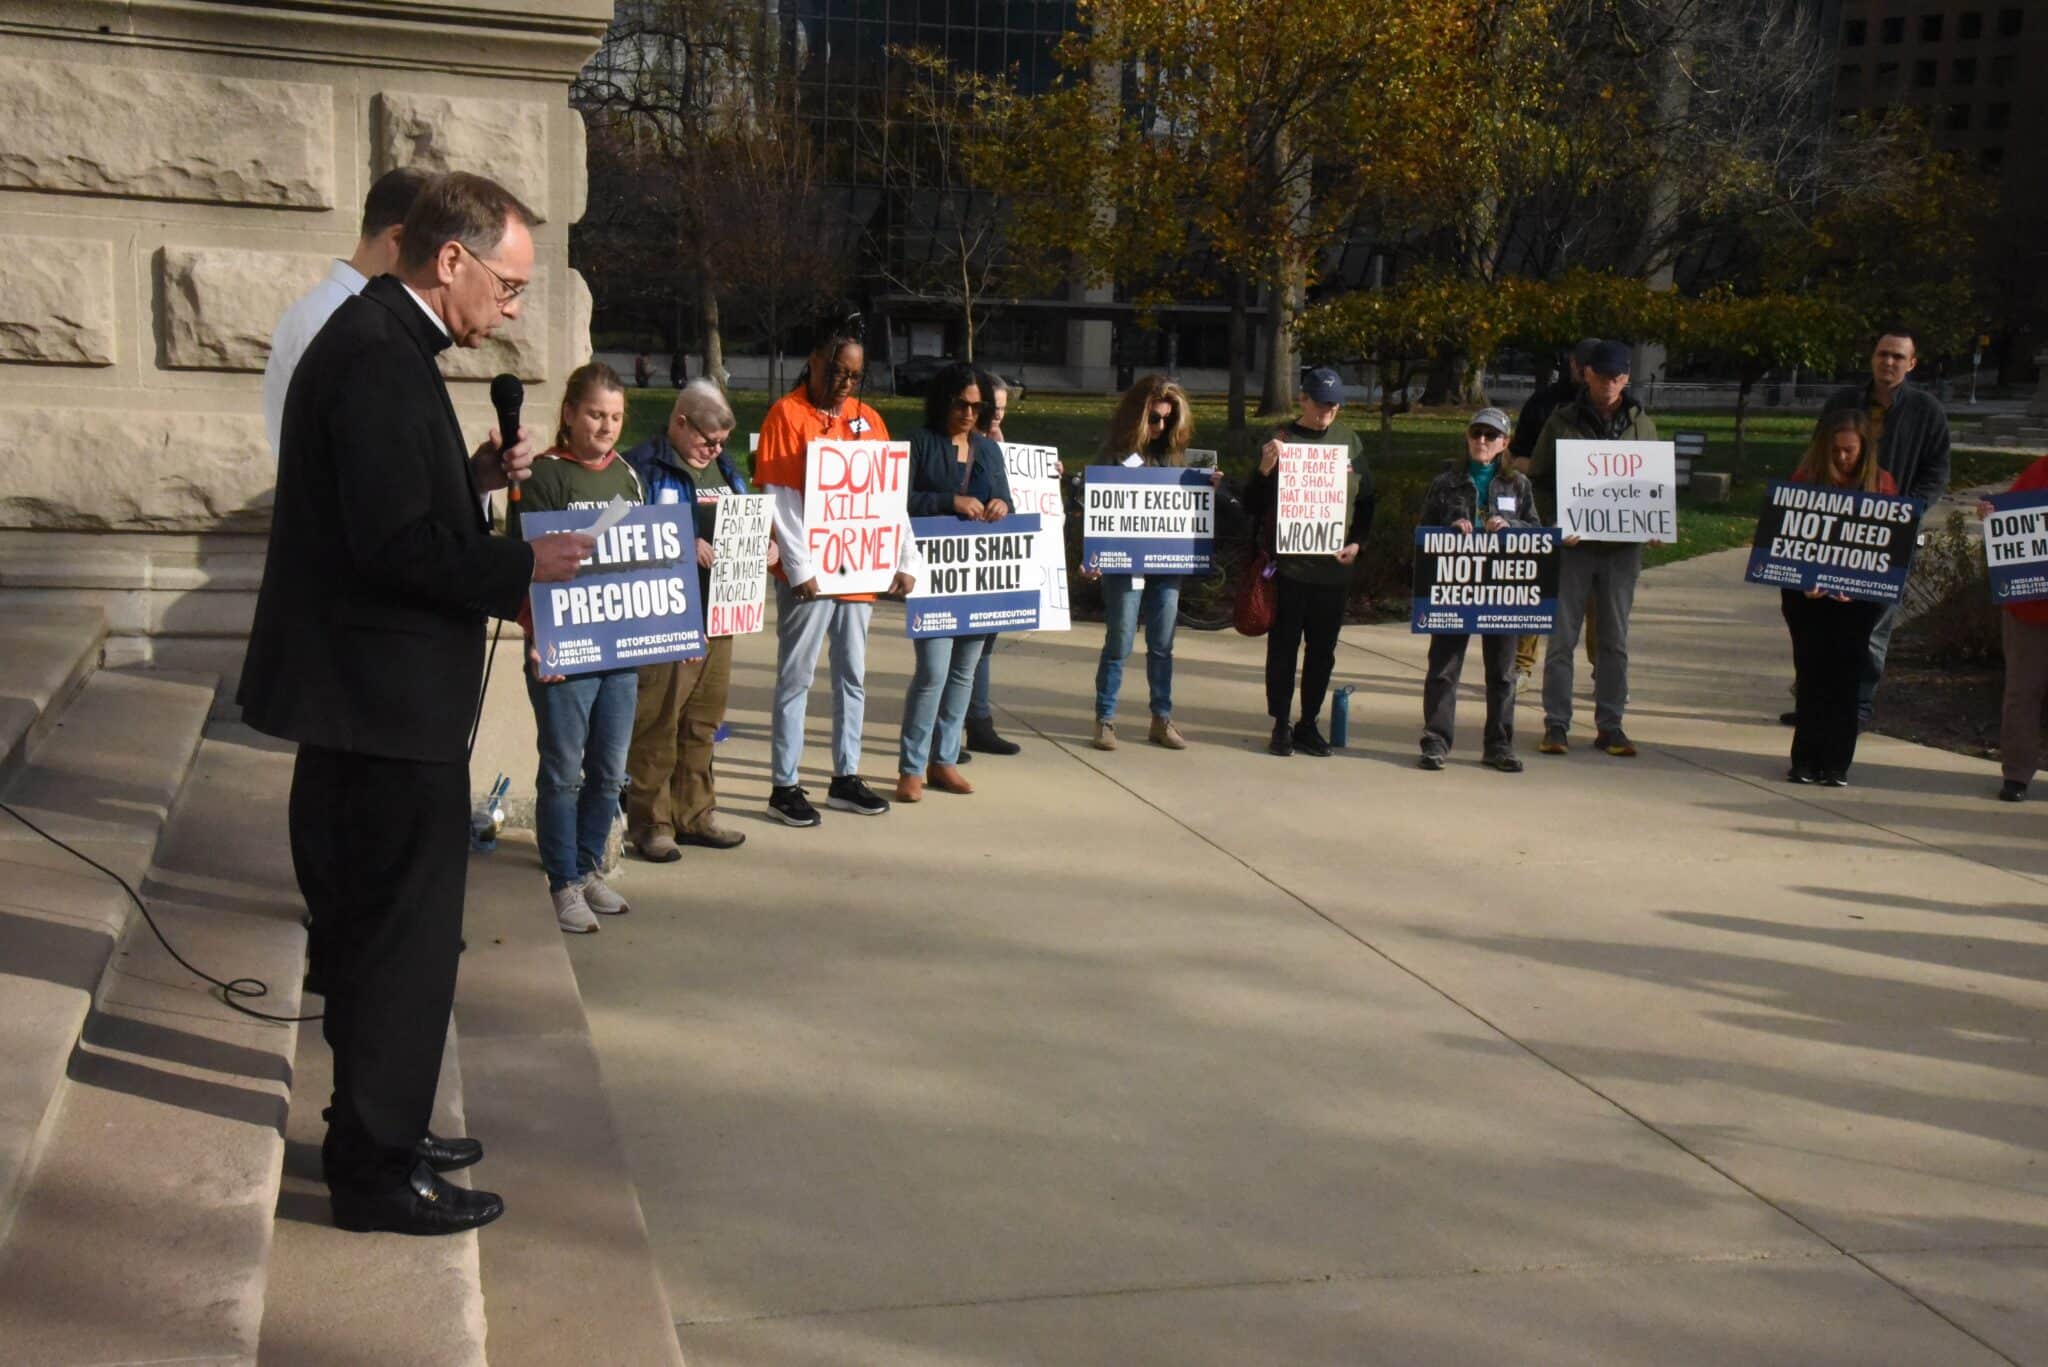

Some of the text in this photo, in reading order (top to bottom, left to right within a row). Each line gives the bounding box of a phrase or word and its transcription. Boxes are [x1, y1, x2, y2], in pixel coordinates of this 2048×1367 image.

[1323, 447, 1338, 461] WE
[1587, 452, 1643, 478] STOP
[818, 444, 908, 495] DON'T
[1279, 460, 1336, 474] KILL PEOPLE
[1283, 474, 1335, 488] TO SHOW
[1571, 482, 1595, 498] the
[1602, 483, 1641, 502] cycle
[823, 491, 881, 522] KILL
[1090, 489, 1210, 511] DON'T EXECUTE
[1279, 487, 1344, 504] THAT KILLING
[1772, 486, 1914, 524] INDIANA DOES
[721, 497, 764, 517] AN EYE
[1280, 504, 1332, 519] PEOPLE IS
[721, 517, 766, 536] FOR AN
[1089, 515, 1209, 534] THE MENTALLY ILL
[1567, 507, 1673, 535] VIOLENCE
[1780, 510, 1892, 547] NOT NEED
[597, 524, 649, 564] LIFE
[652, 522, 681, 560] IS
[736, 535, 768, 559] MAKES
[1278, 521, 1343, 552] WRONG
[1424, 533, 1553, 554] INDIANA DOES
[808, 527, 858, 575] FOR
[915, 534, 1034, 565] THOU SHALT
[1770, 537, 1892, 574] EXECUTIONS
[1992, 541, 2026, 561] THE
[712, 559, 765, 583] THE WHOLE
[930, 565, 1021, 595] NOT KILL!
[1436, 555, 1538, 584] NOT NEED
[715, 581, 757, 603] WORLD
[1817, 573, 1900, 592] #STOPEXECUTIONS
[551, 577, 687, 627] PRECIOUS
[1430, 584, 1541, 606] EXECUTIONS
[711, 603, 763, 635] BLIND!
[559, 638, 593, 649] INDIANA
[616, 630, 699, 648] #STOPEXECUTIONS
[559, 646, 601, 658] ABOLITION
[559, 653, 602, 666] COALITION
[617, 642, 700, 659] INDIANAABOLITION.ORG
